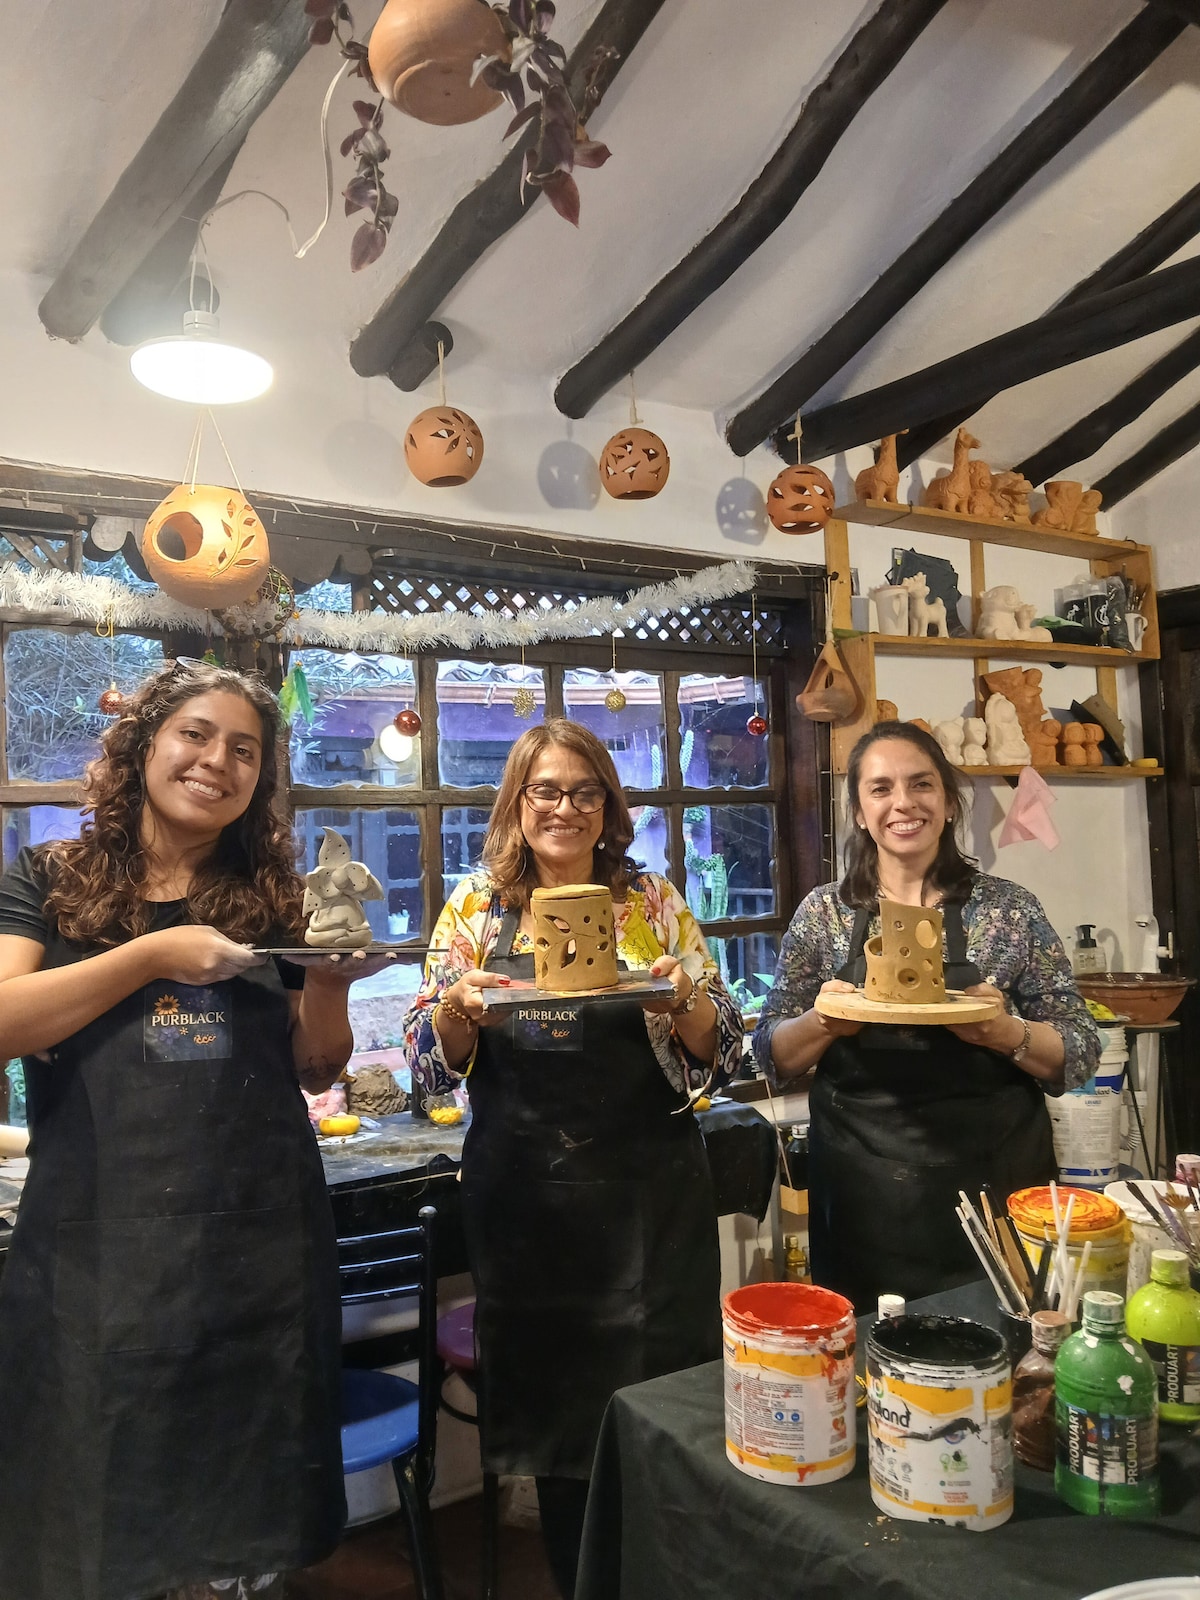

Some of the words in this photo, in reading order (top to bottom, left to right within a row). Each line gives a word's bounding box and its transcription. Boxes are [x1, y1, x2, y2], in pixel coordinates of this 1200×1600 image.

[151, 1011, 226, 1027] PURBLACK
[518, 1009, 578, 1021] PURBLACK
[1166, 1343, 1179, 1405] PRODUART
[1068, 1406, 1080, 1476] PRODUART
[1126, 1417, 1139, 1486] PRODUART
